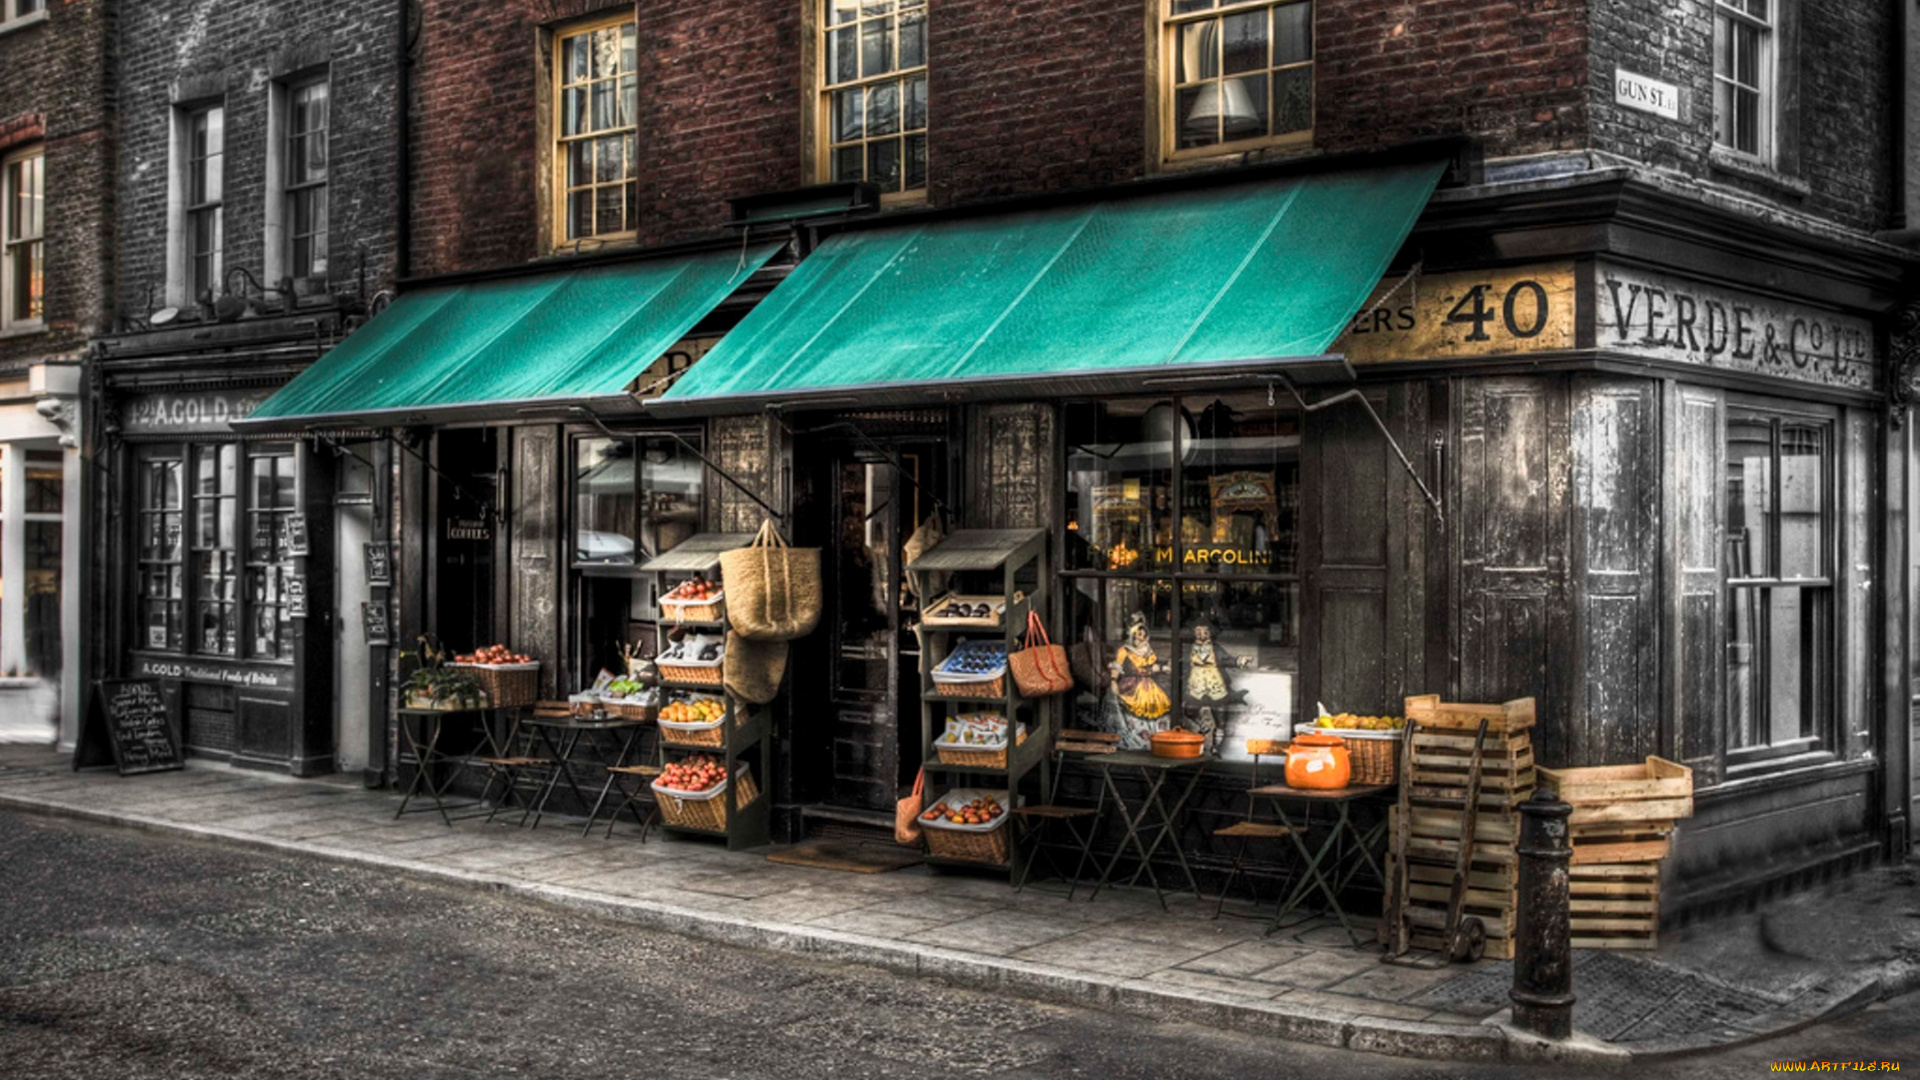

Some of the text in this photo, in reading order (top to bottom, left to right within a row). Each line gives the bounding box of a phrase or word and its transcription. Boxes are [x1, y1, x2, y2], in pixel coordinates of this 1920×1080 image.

[1618, 78, 1647, 101] GUN
[1441, 280, 1549, 342] 40
[1605, 279, 1755, 359] VERDE
[1762, 322, 1782, 365] &
